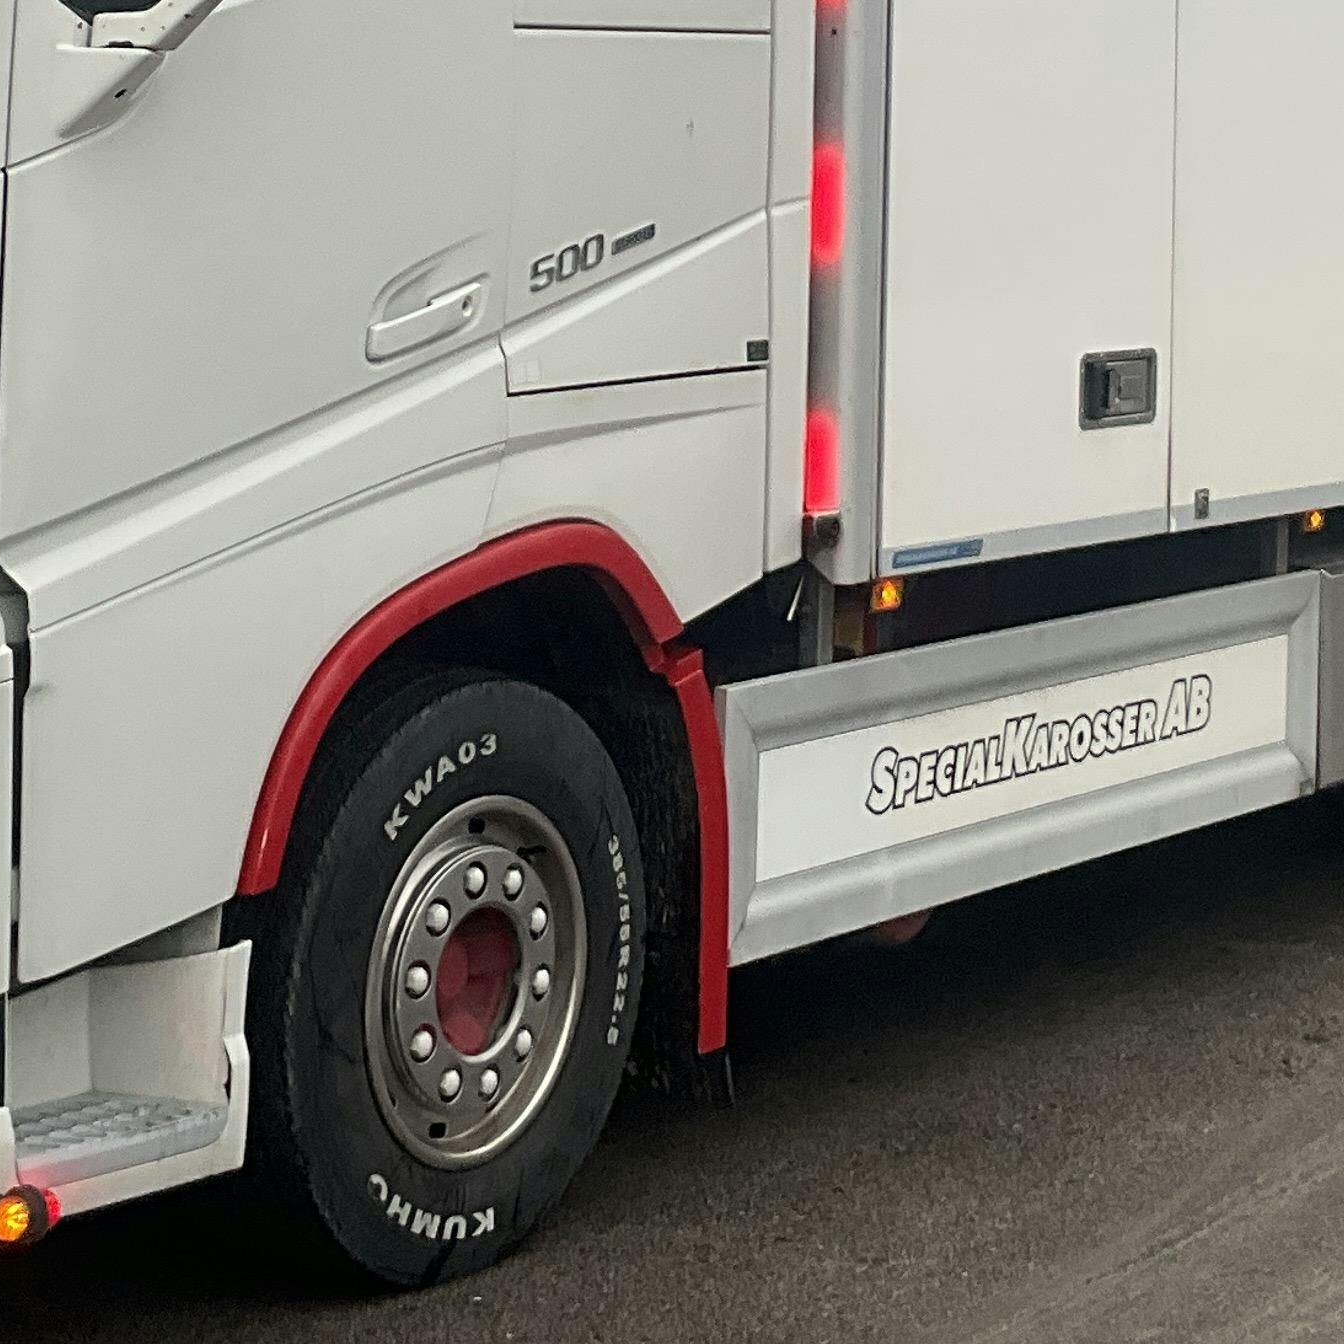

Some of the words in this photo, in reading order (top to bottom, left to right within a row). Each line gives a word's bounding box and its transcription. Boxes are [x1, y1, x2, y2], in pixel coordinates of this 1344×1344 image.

[529, 233, 604, 292] 500
[1160, 674, 1212, 740] AB
[383, 733, 498, 840] KWA03
